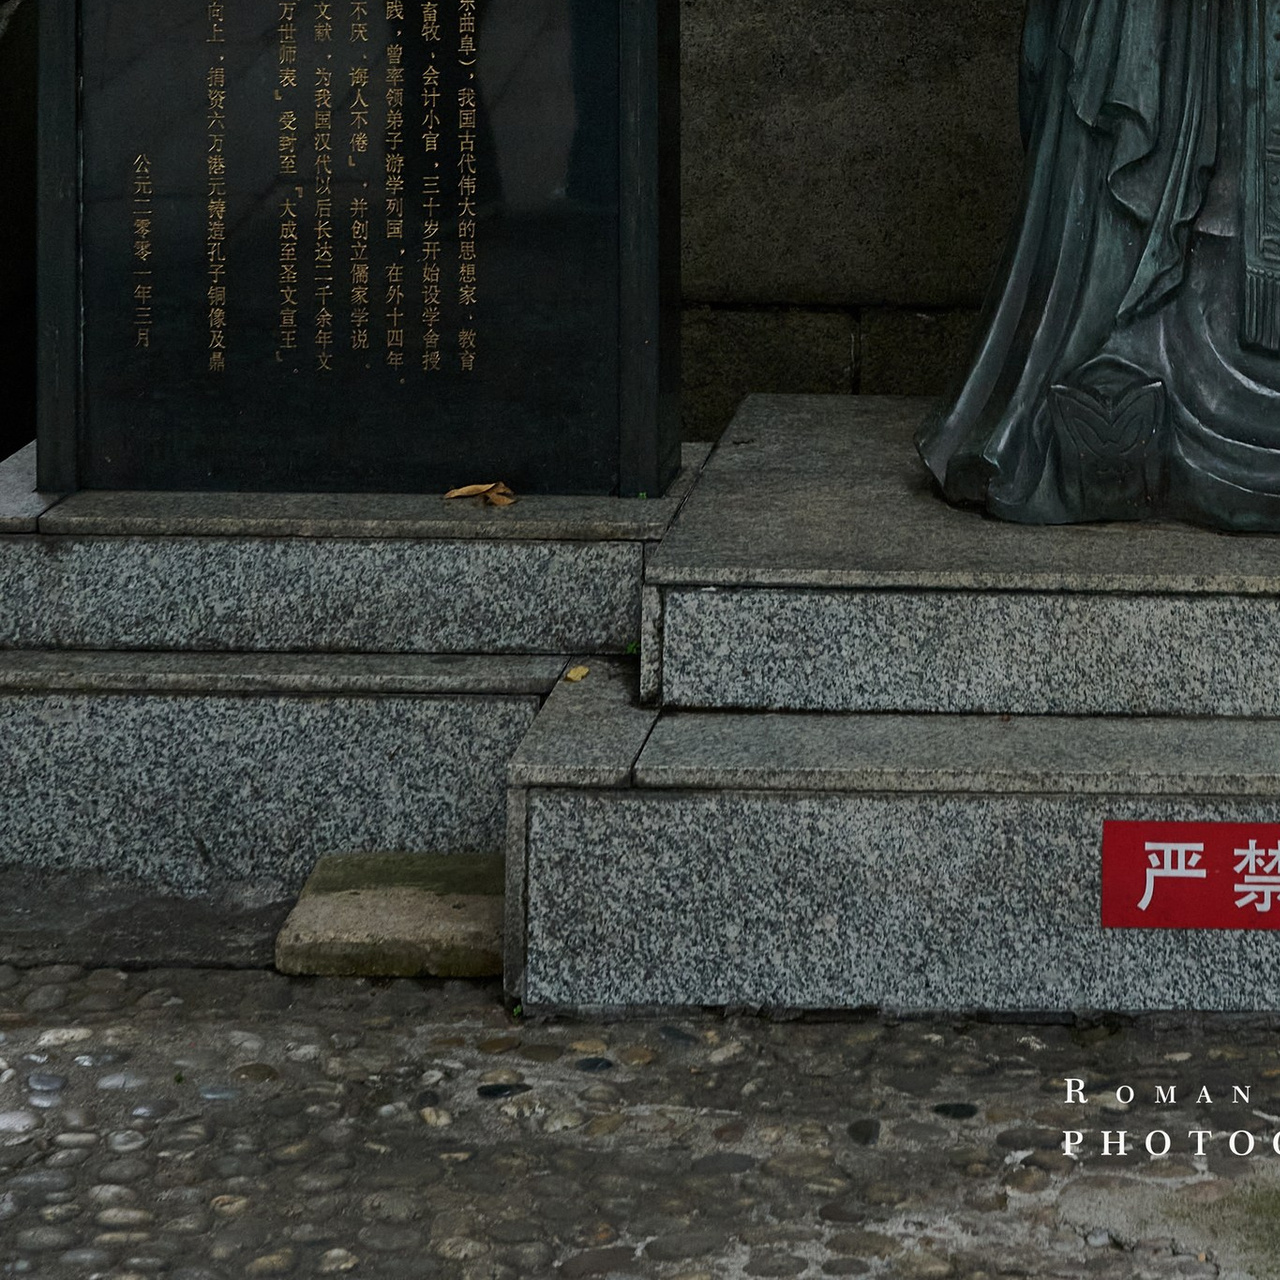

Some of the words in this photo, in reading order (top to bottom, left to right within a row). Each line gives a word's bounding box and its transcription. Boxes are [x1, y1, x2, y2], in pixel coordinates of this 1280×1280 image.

[133, 153, 153, 348] 公元二零零一年三月
